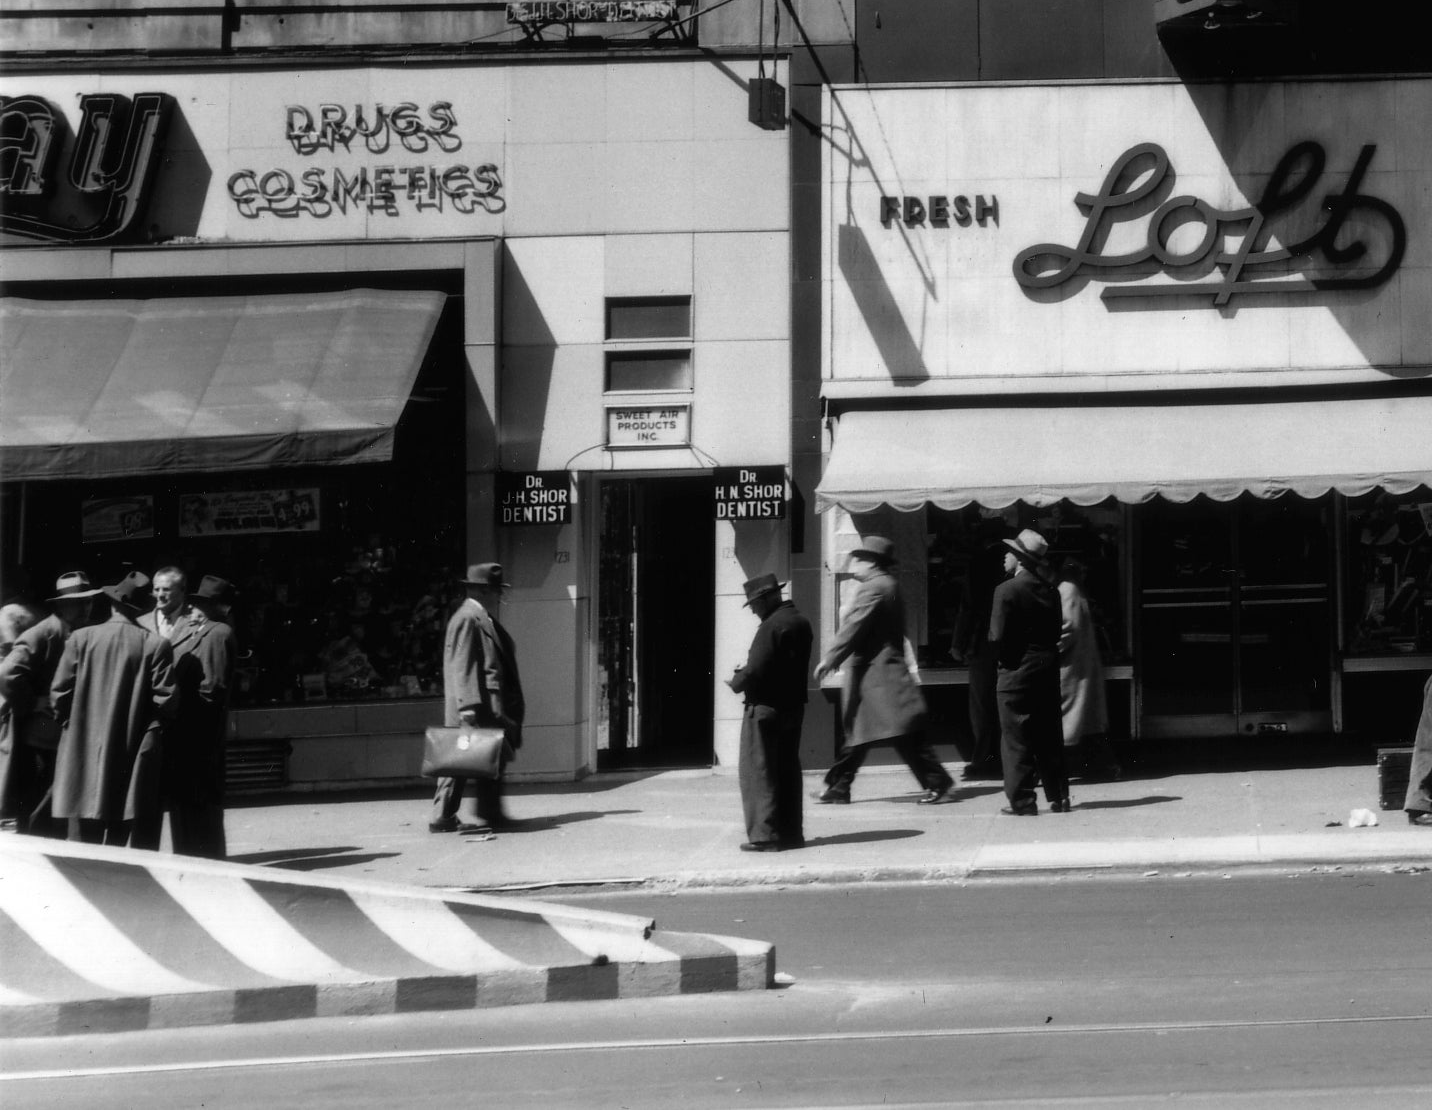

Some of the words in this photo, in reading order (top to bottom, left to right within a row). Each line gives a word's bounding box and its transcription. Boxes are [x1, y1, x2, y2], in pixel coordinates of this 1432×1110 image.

[285, 101, 457, 140] DRUGS
[227, 164, 502, 204] COSMETICS
[879, 194, 1000, 230] FRESH
[616, 411, 653, 420] SWEET
[659, 410, 679, 419] AIR
[617, 421, 677, 431] PRODUCTS
[530, 489, 568, 504] SHOR
[743, 484, 783, 499] SHOR
[503, 505, 566, 523] DENTIST
[716, 500, 781, 518] DENTIST
